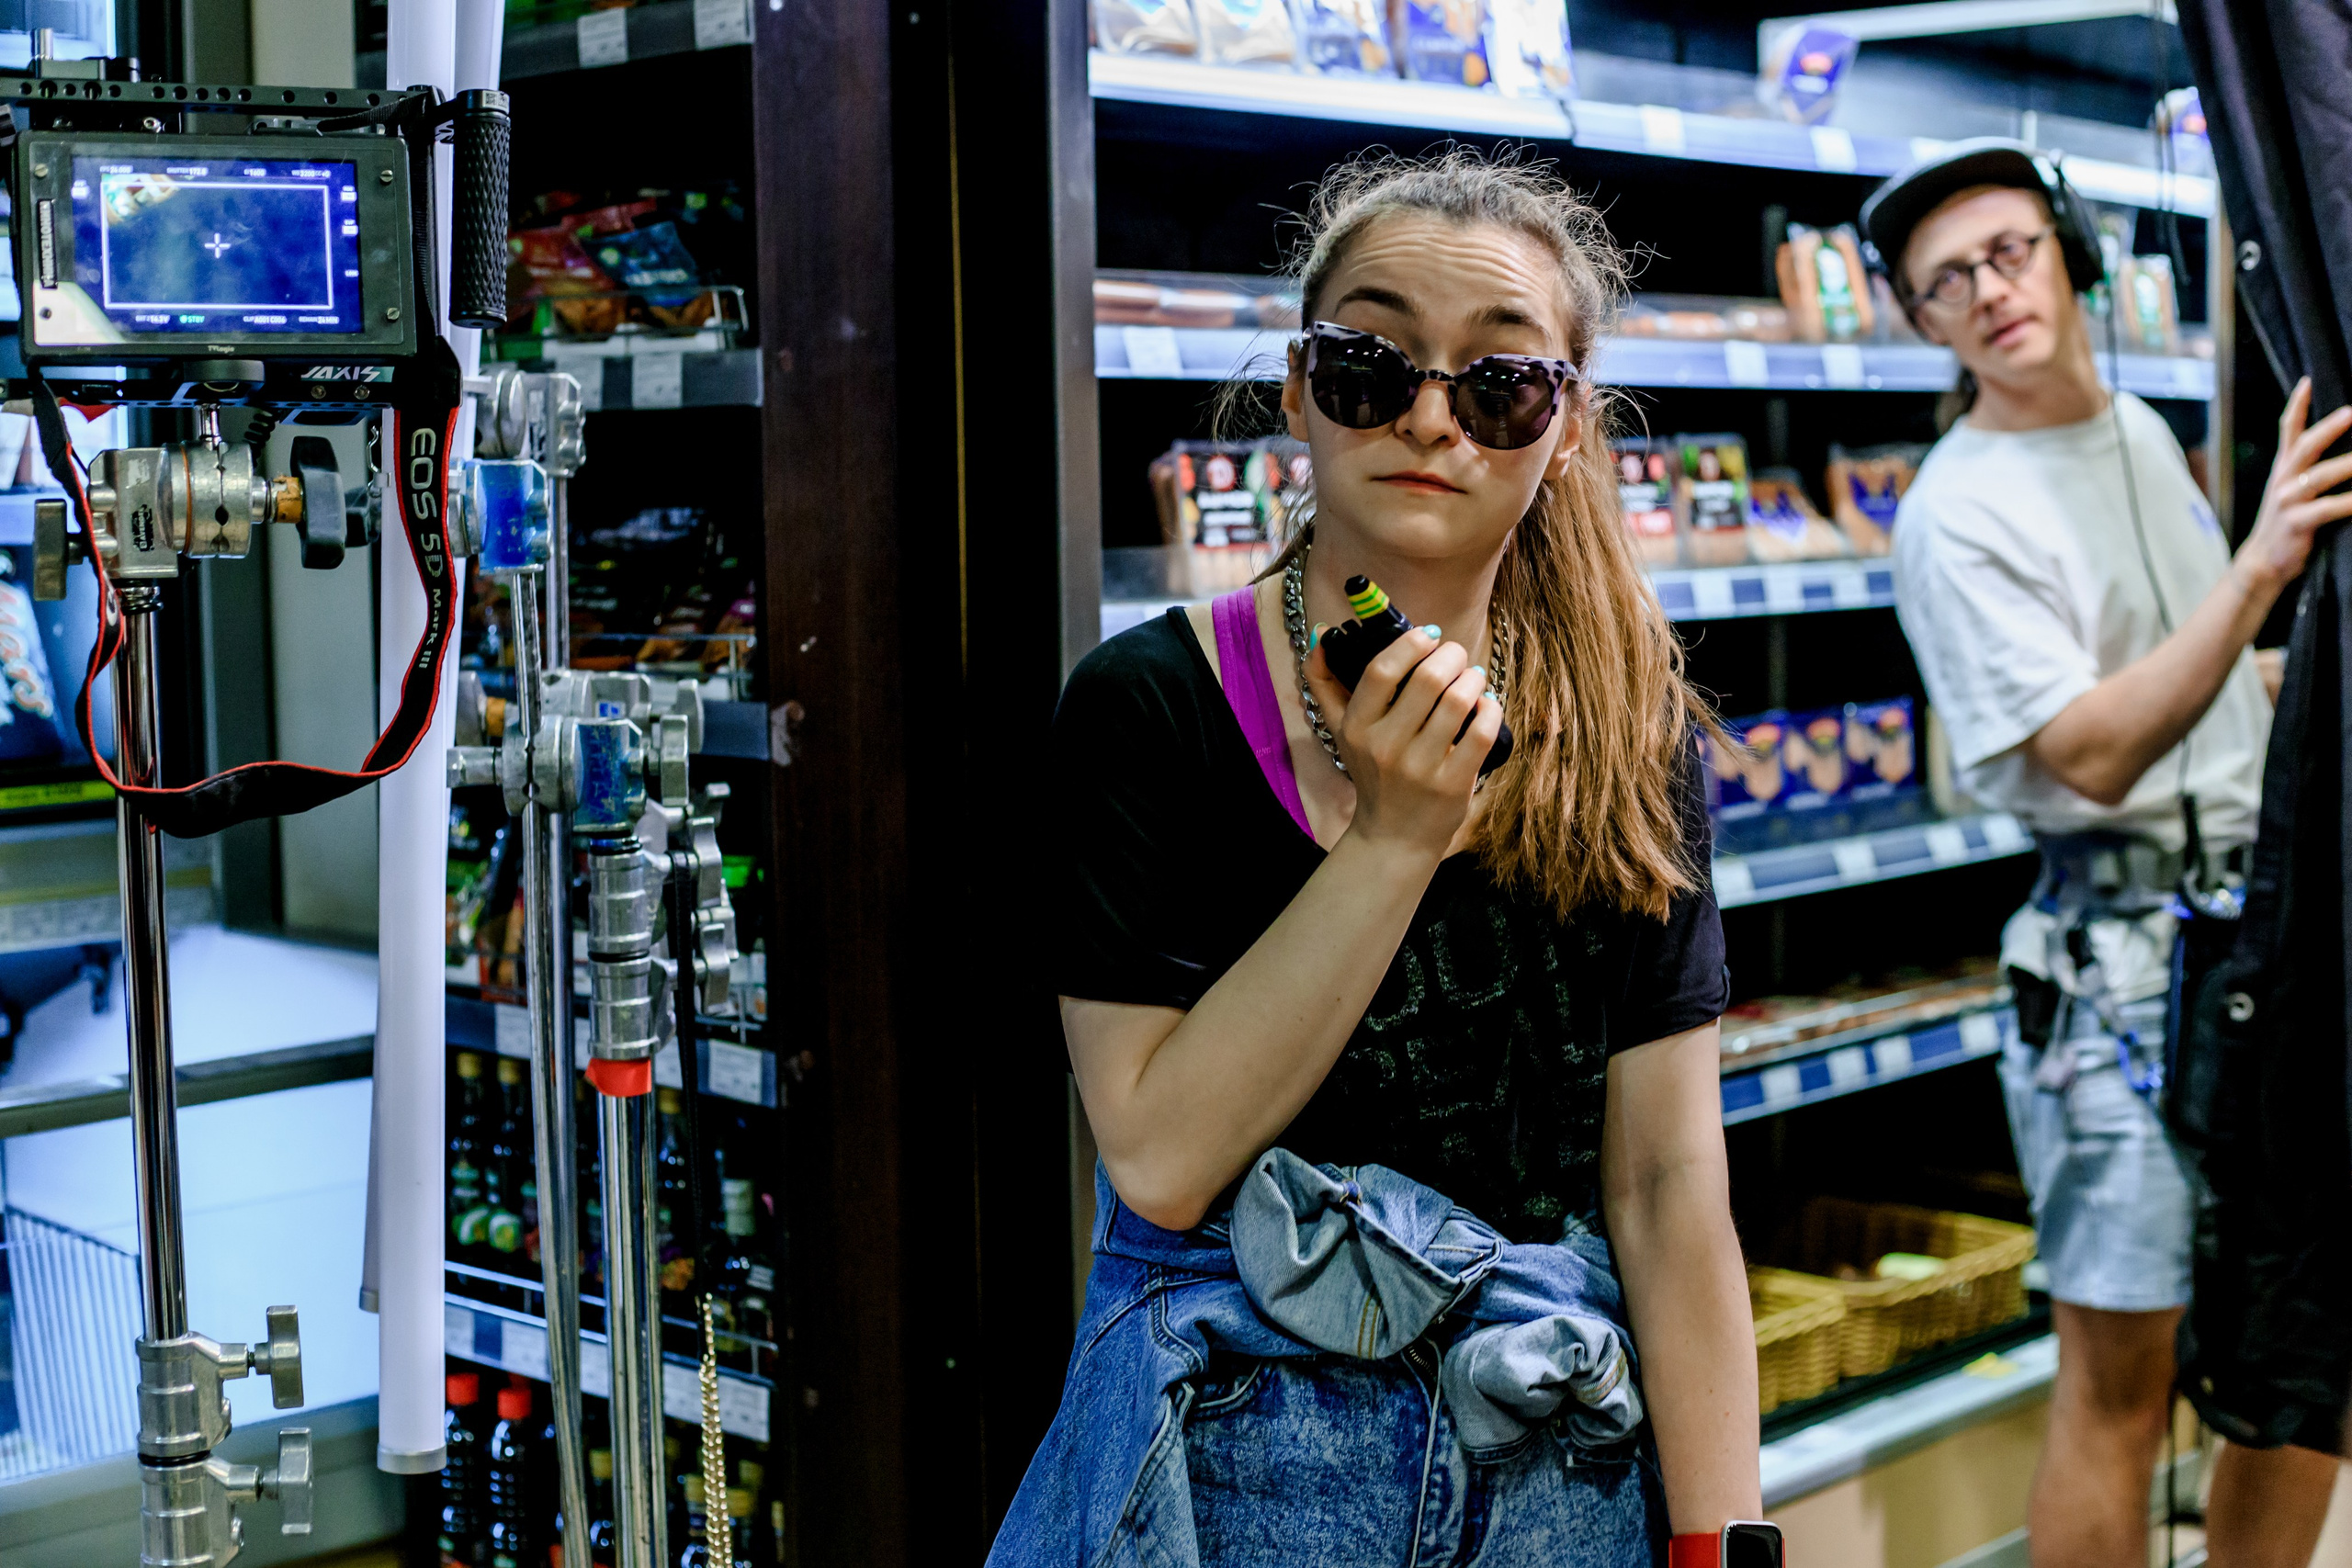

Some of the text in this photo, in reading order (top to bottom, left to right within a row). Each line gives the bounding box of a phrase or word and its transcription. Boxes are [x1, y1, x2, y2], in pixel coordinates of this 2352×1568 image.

[250, 168, 266, 176] 1600
[300, 169, 315, 177] 3200
[187, 315, 205, 323] STBY
[410, 427, 437, 521] EOS
[420, 532, 444, 578] 5D
[425, 588, 442, 646] Mark
